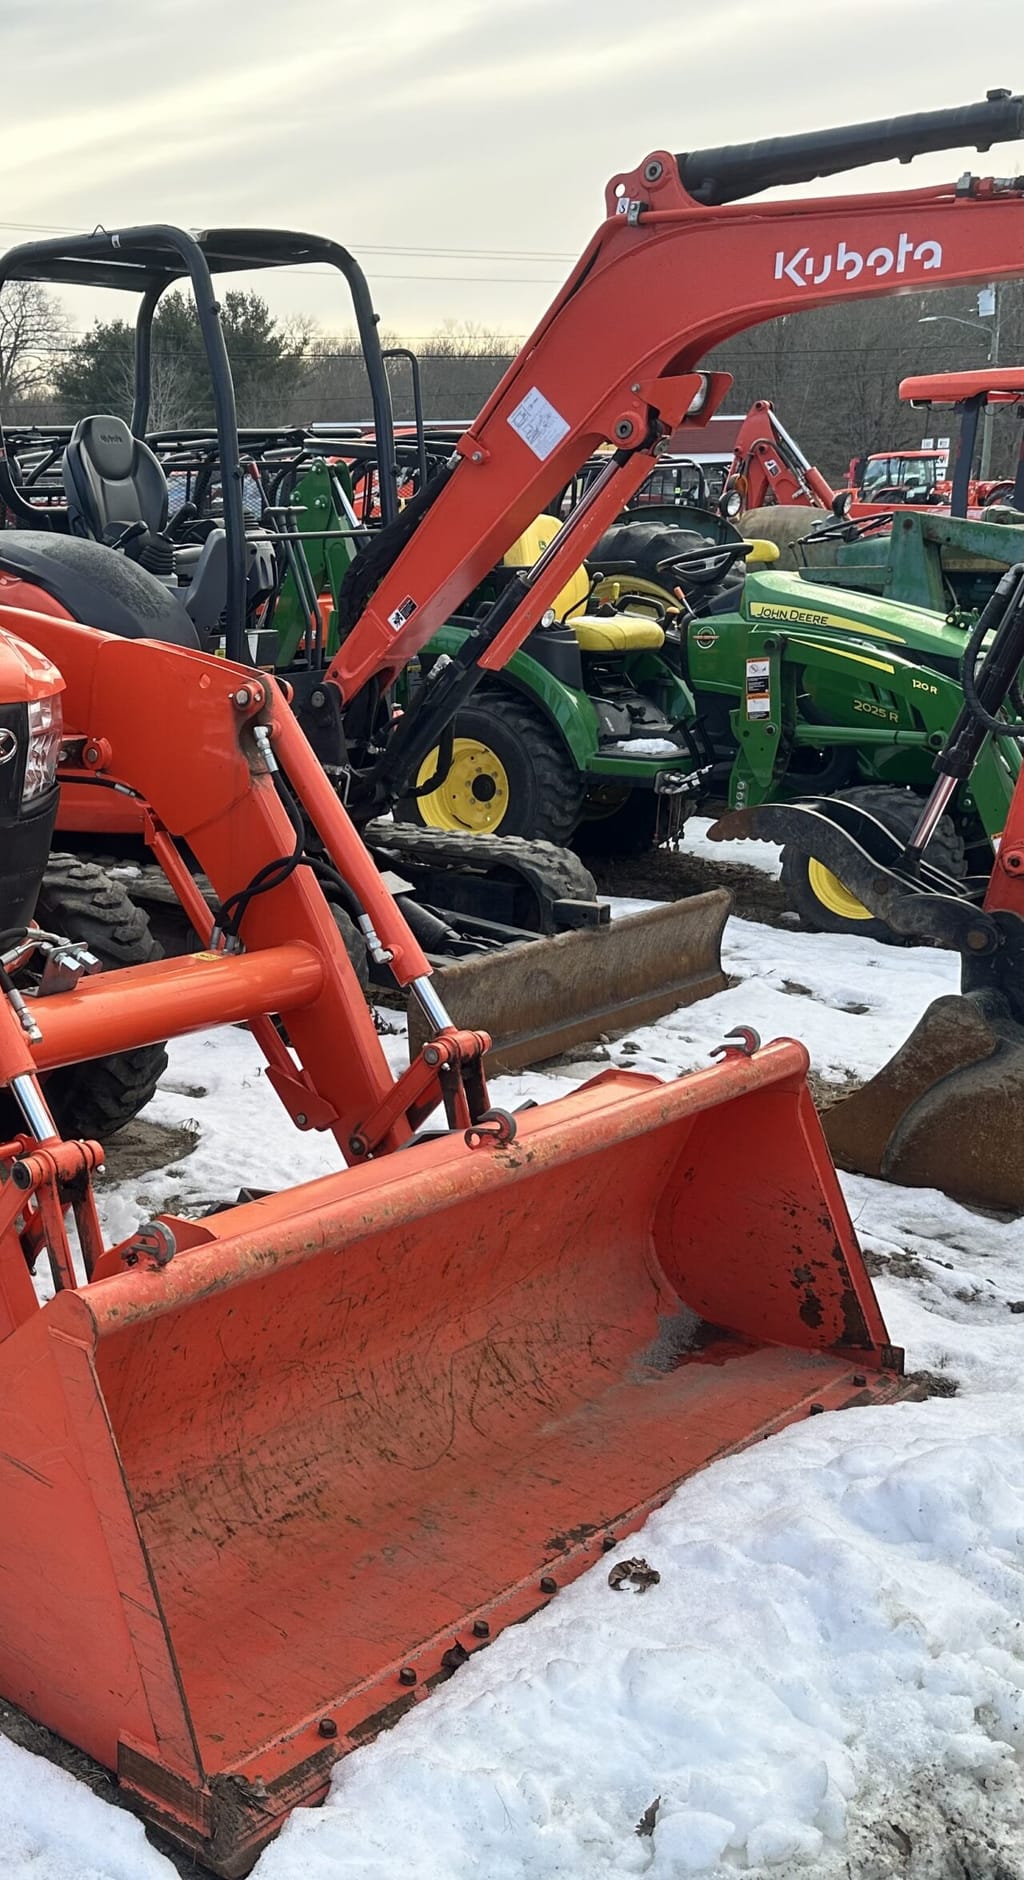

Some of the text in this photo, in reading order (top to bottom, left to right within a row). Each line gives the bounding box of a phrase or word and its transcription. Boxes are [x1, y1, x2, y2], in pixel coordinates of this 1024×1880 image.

[774, 232, 942, 287] Kubota
[756, 607, 829, 625] JOHN DEERE
[912, 679, 938, 695] 120 R
[853, 699, 899, 723] 2025 R
